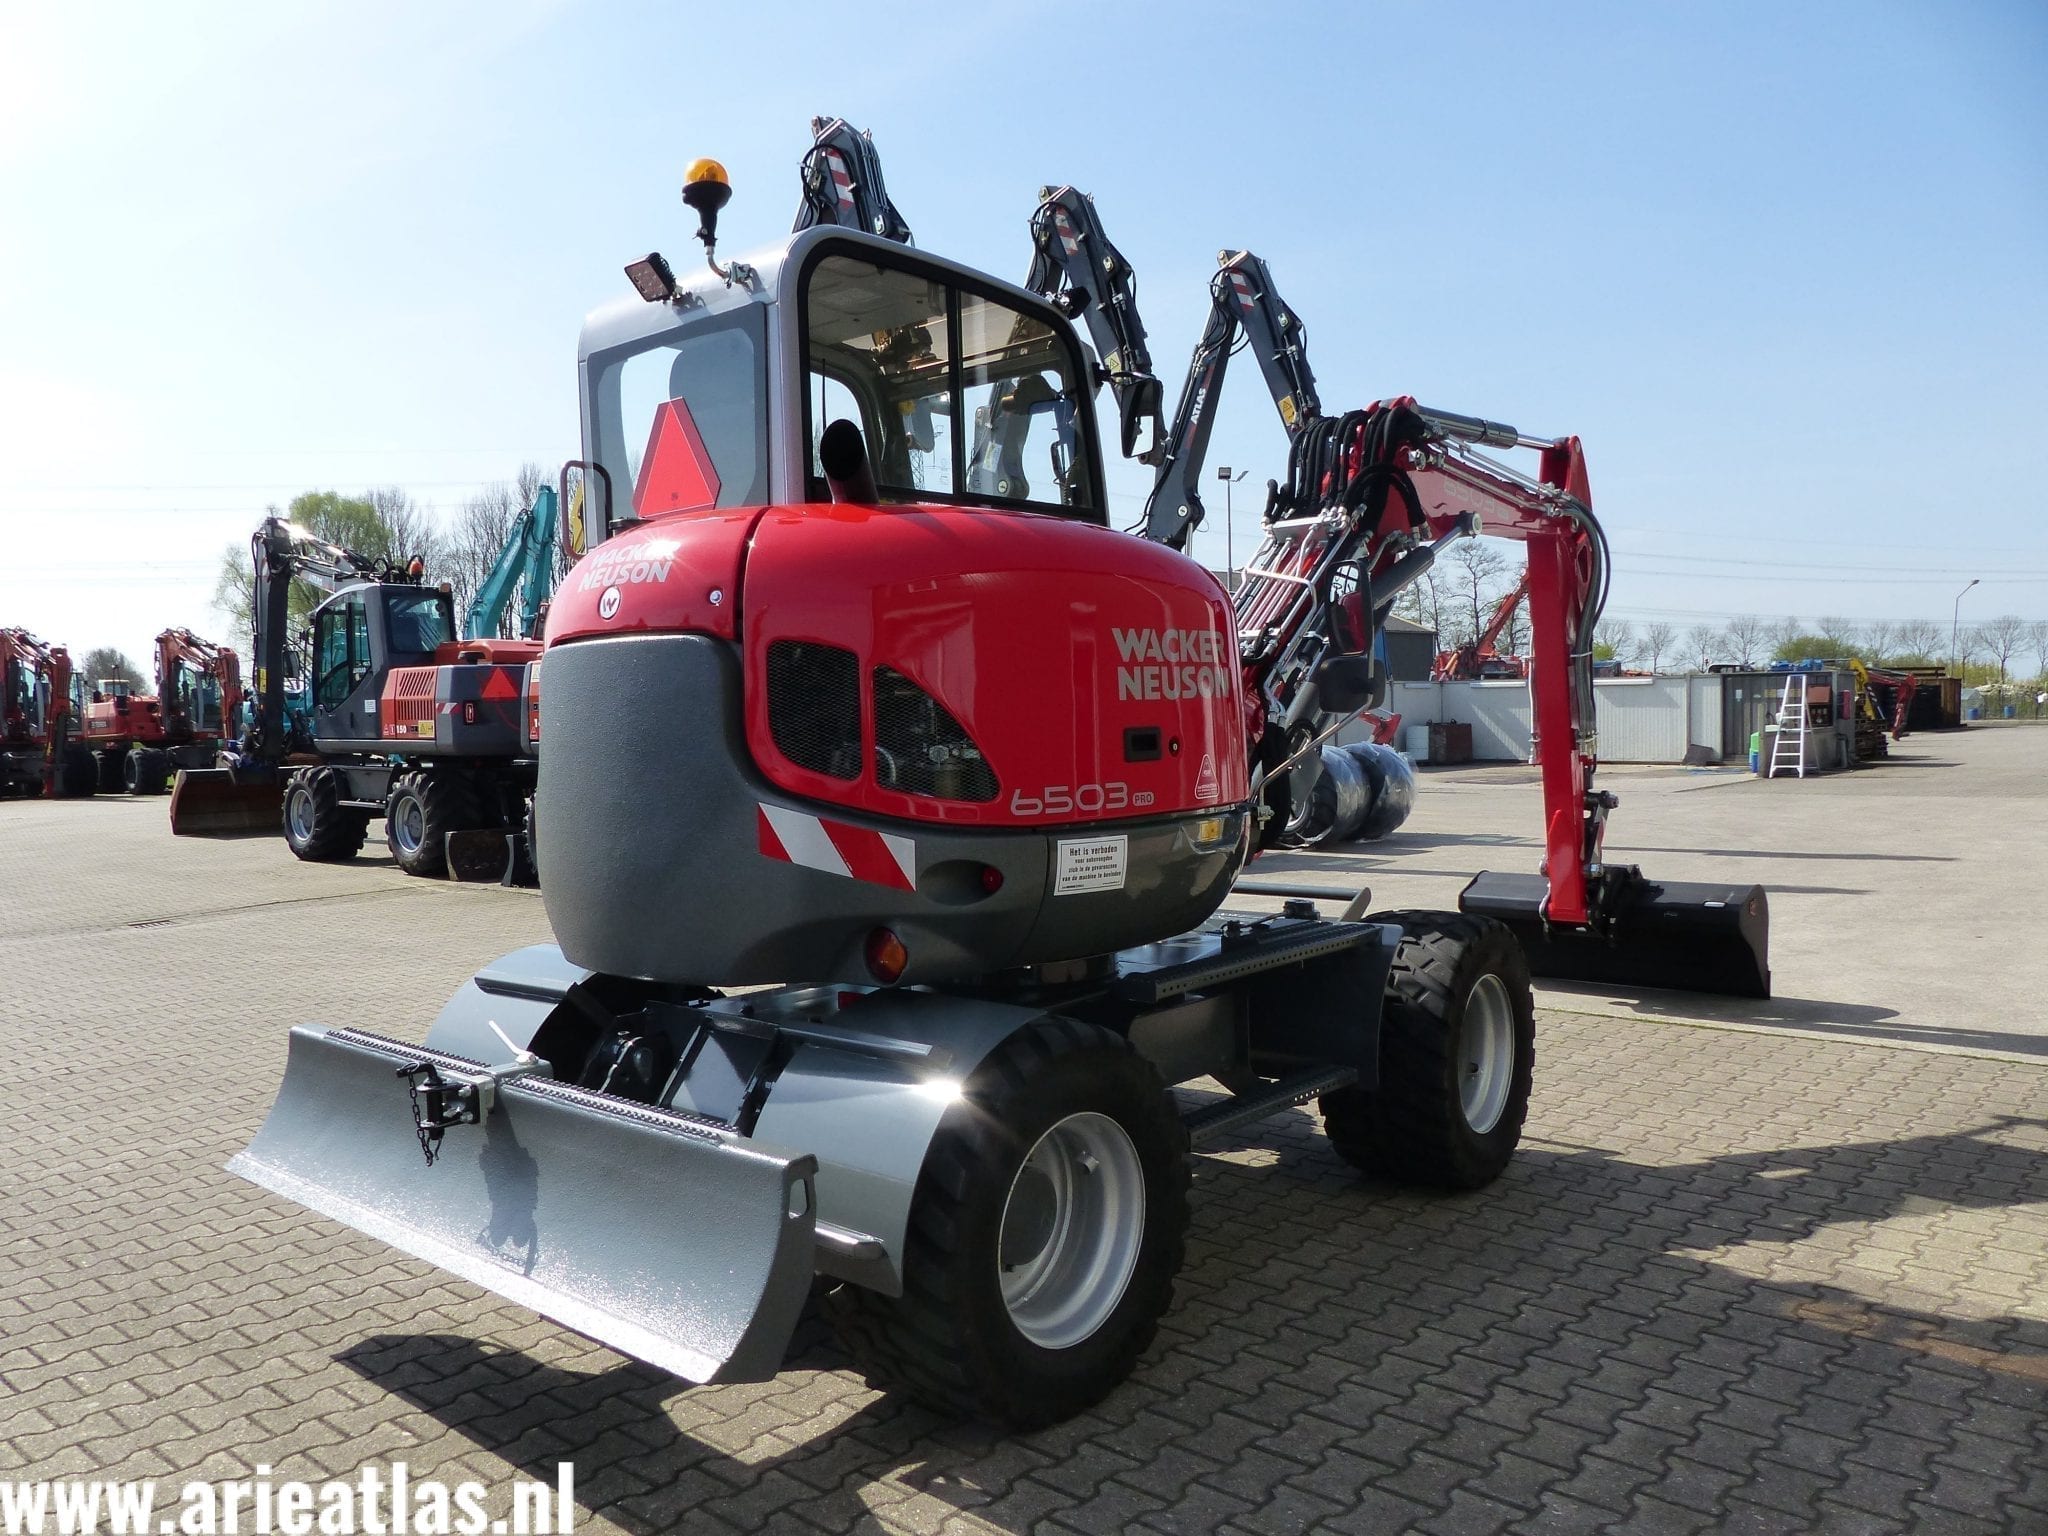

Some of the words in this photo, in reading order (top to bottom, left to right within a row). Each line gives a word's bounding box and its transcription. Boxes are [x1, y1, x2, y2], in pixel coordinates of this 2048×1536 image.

[590, 540, 681, 570] WACKR
[578, 561, 672, 593] NEUSON
[1111, 627, 1227, 663] WACKER
[1117, 665, 1229, 701] NEUSON
[1010, 781, 1129, 816] 6503
[1134, 794, 1153, 804] PRO
[1070, 848, 1080, 856] Het
[1091, 845, 1117, 854] verboden
